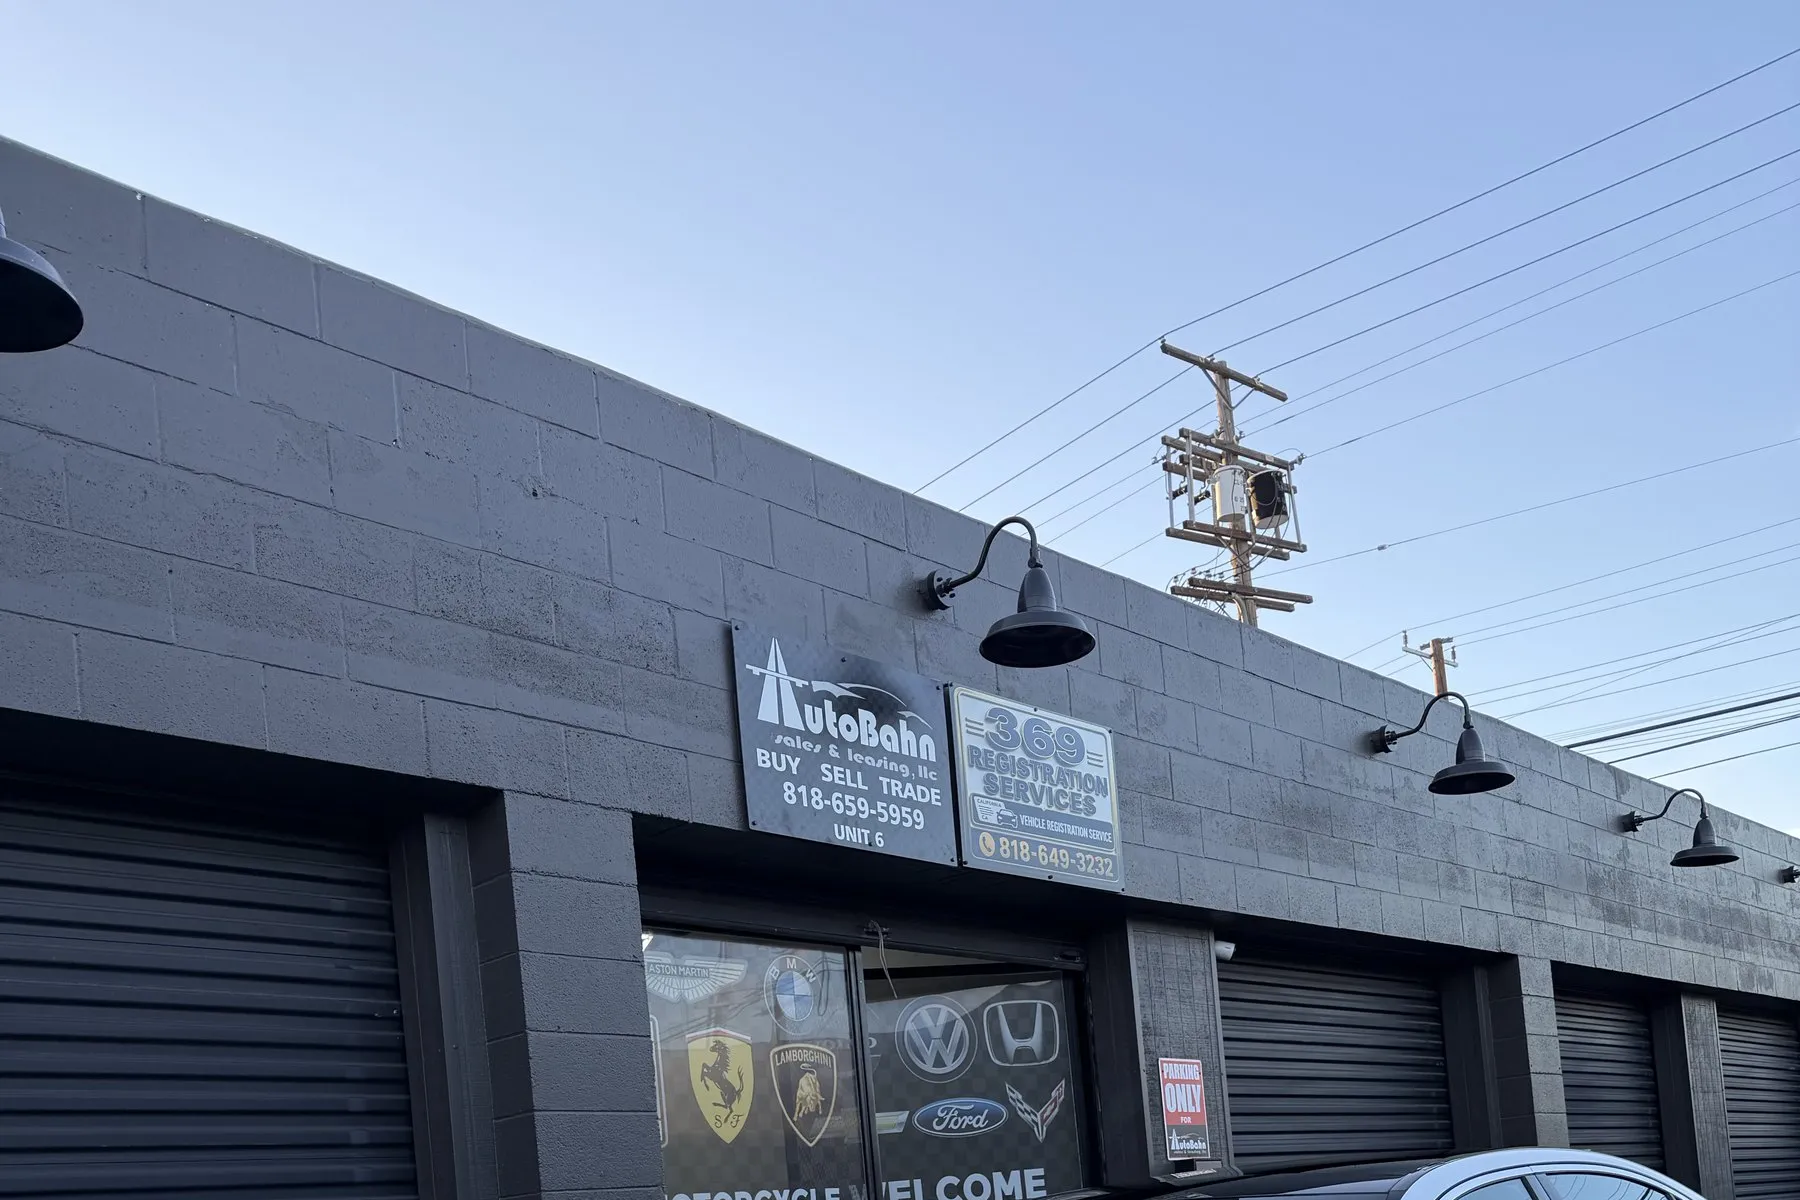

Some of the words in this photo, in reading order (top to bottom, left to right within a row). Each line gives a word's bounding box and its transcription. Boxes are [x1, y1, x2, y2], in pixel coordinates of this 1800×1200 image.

[746, 637, 936, 762] AutoBahn
[984, 707, 1086, 767] 369
[774, 734, 822, 753] sales
[828, 744, 840, 758] &
[848, 748, 915, 780] leasing,
[918, 765, 938, 781] llc
[967, 745, 1109, 798] REGISTRATION
[756, 748, 801, 775] BUY
[820, 763, 869, 790] SELL
[878, 776, 942, 806] TRADE
[982, 773, 1097, 817] SERVICES
[783, 781, 925, 830] 818-659-5959
[834, 823, 871, 846] UNIT
[875, 832, 885, 848] 6
[1019, 814, 1046, 830] VEHICLE
[1046, 820, 1089, 837] REGISTRATION
[1088, 829, 1113, 843] SERVICE
[999, 836, 1114, 877] 818-649-3232
[650, 963, 677, 975] ASTON
[678, 966, 709, 978] MARTIN
[775, 1049, 833, 1069] LAMBORGHINI
[1163, 1063, 1200, 1080] PARKING
[1164, 1082, 1201, 1113] ONLY
[932, 1103, 989, 1131] Ford
[1180, 1116, 1192, 1124] FOR
